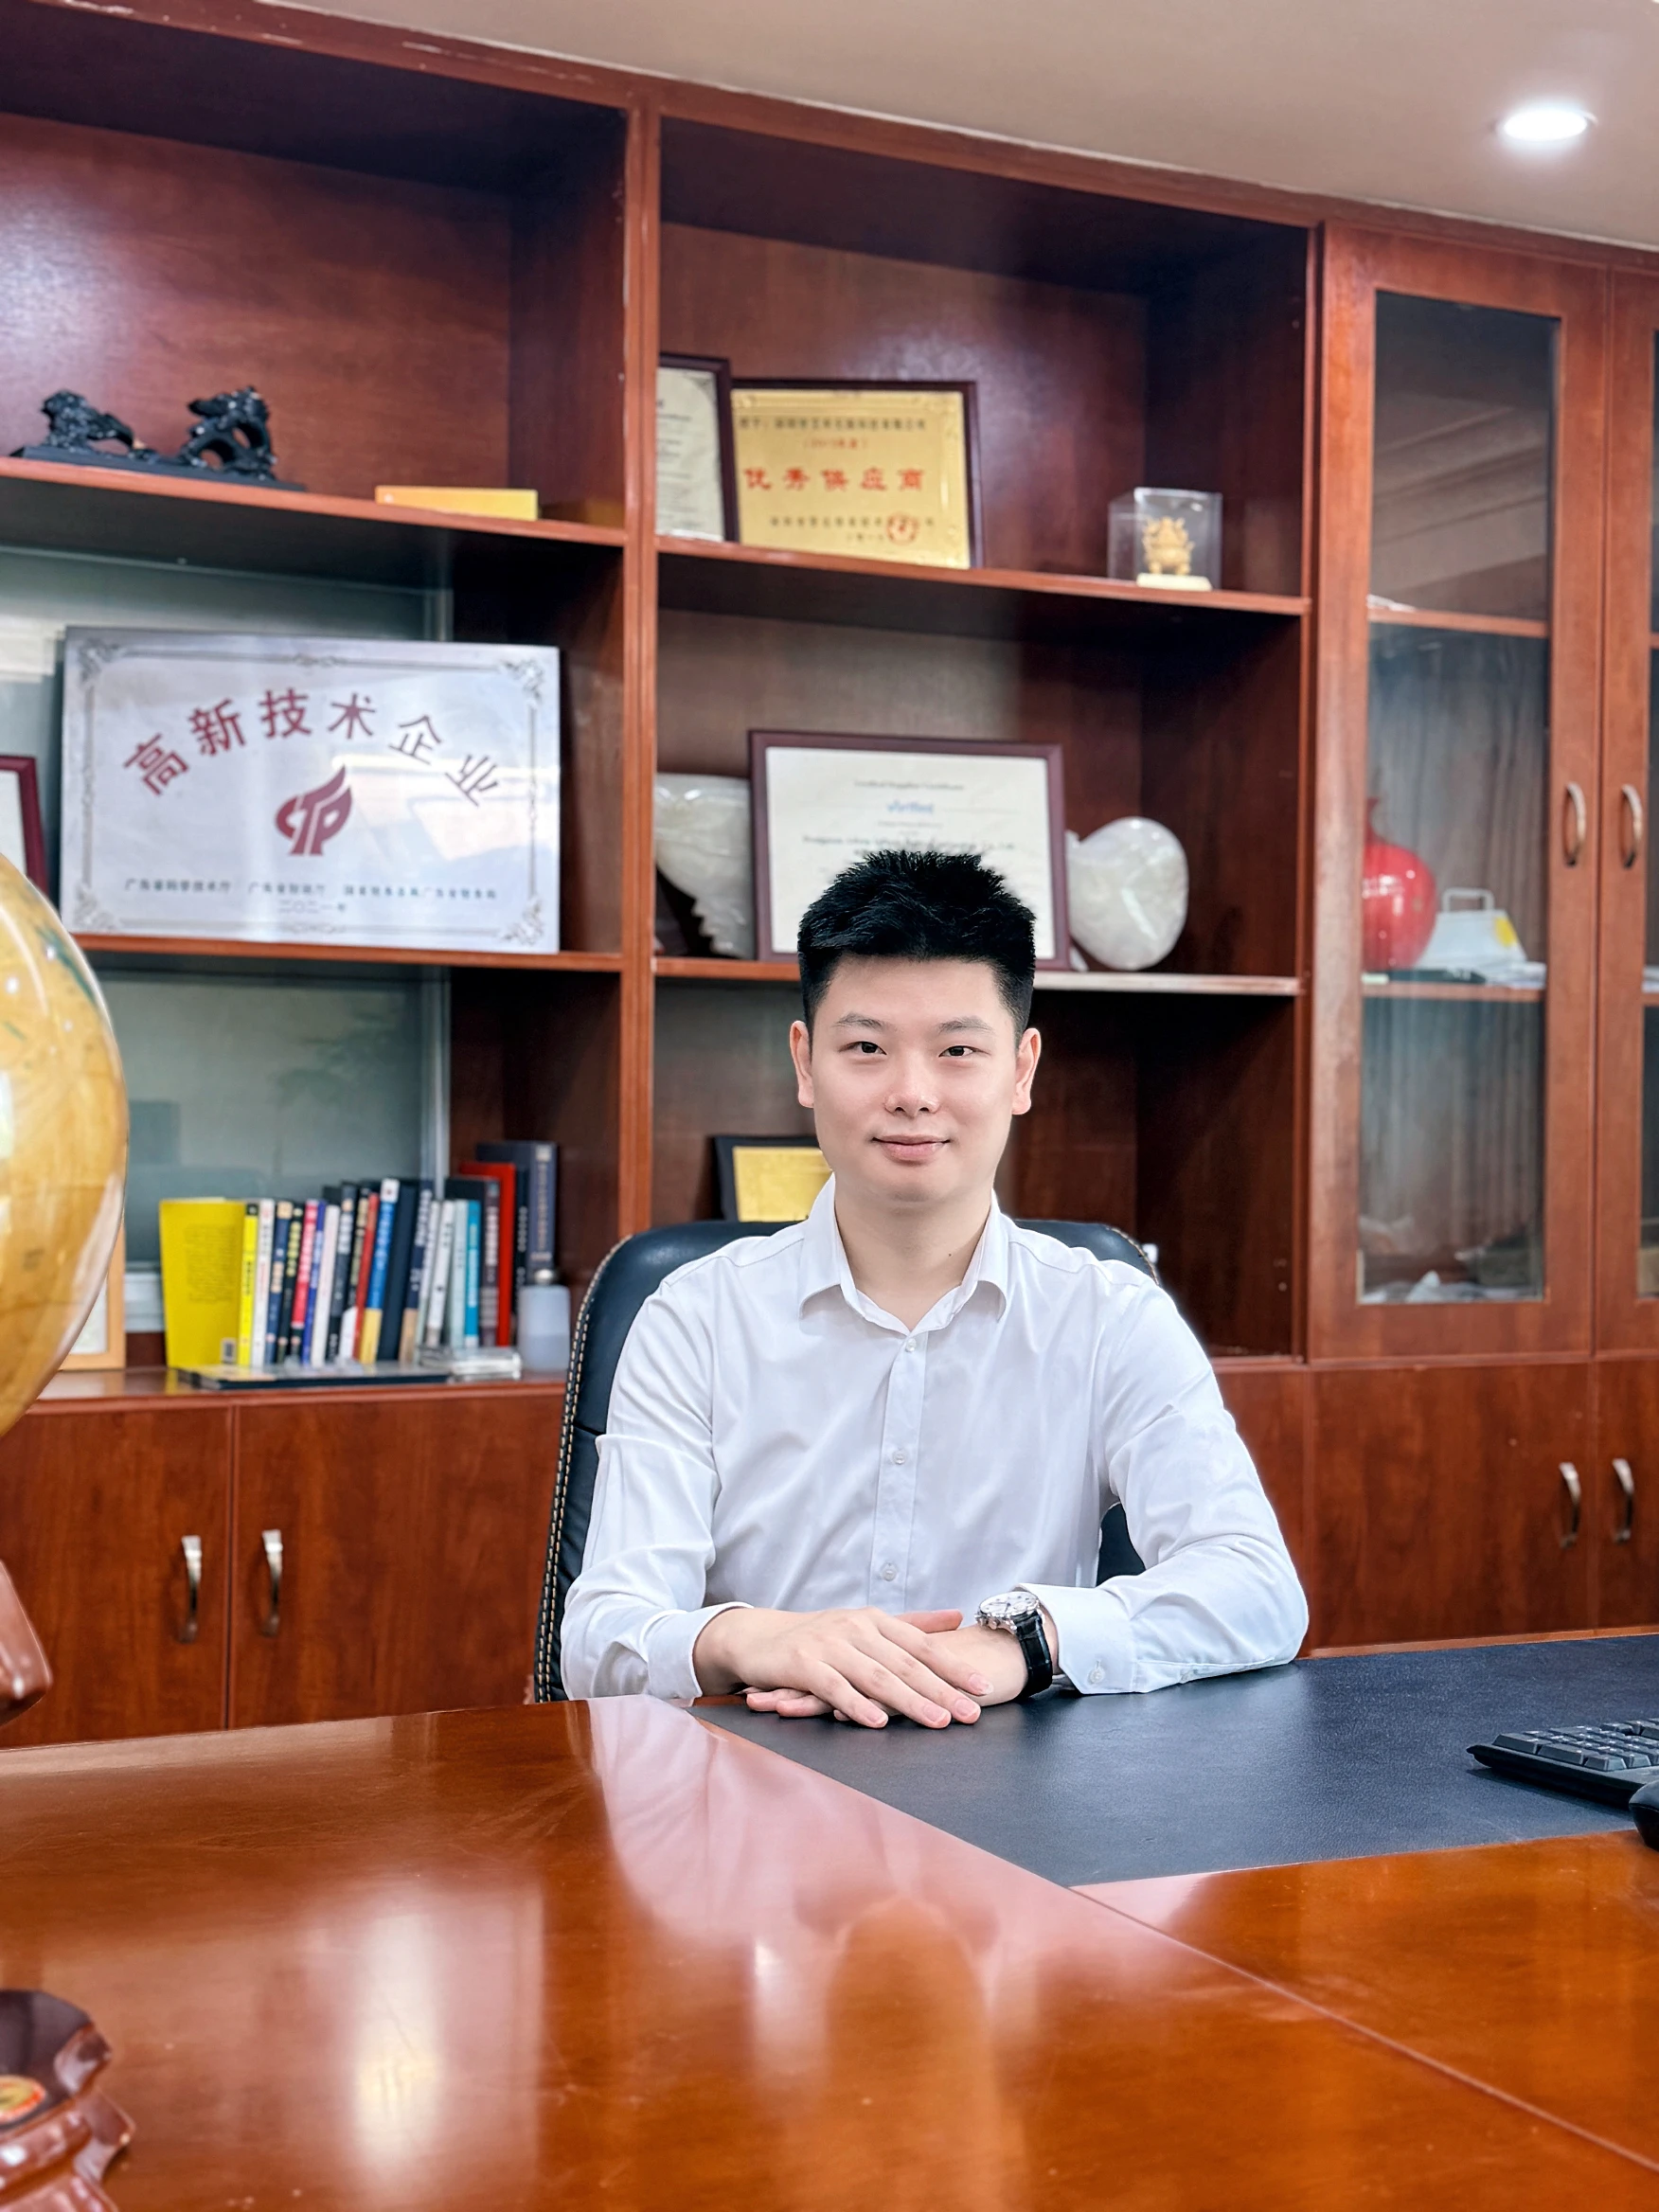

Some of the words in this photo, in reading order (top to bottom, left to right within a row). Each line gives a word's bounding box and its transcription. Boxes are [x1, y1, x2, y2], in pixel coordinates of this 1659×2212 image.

[123, 687, 499, 807] 高新技术企业
